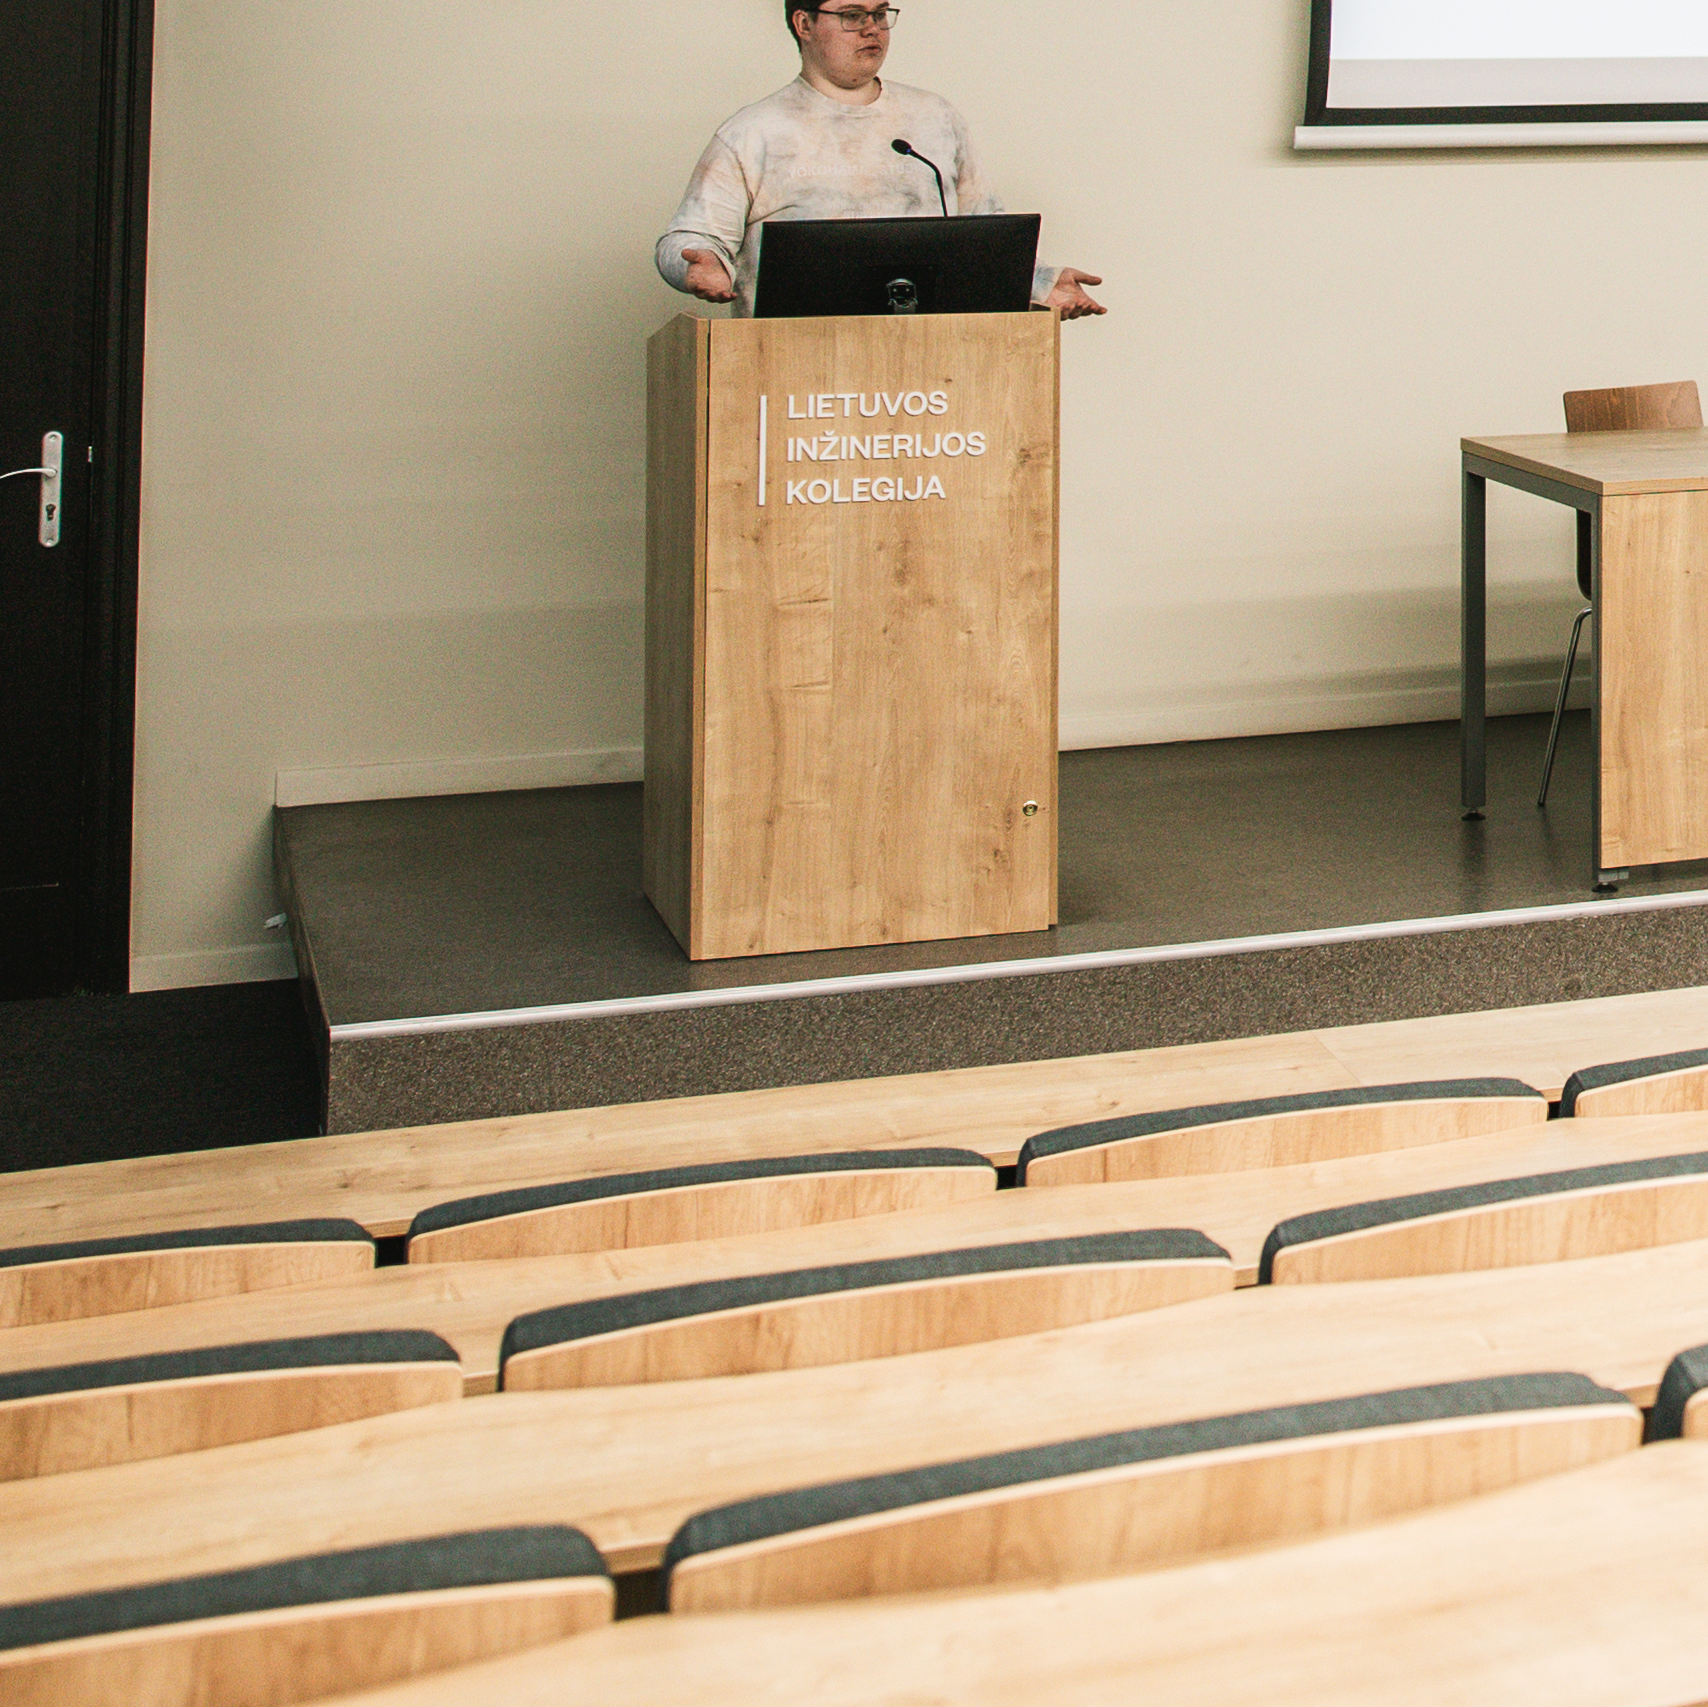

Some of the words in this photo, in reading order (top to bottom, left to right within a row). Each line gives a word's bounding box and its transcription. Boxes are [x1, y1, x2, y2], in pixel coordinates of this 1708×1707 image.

[788, 389, 949, 419] LIETUVOS
[787, 430, 987, 461] INŽINERIJOS
[785, 474, 946, 504] KOLEGIJA
